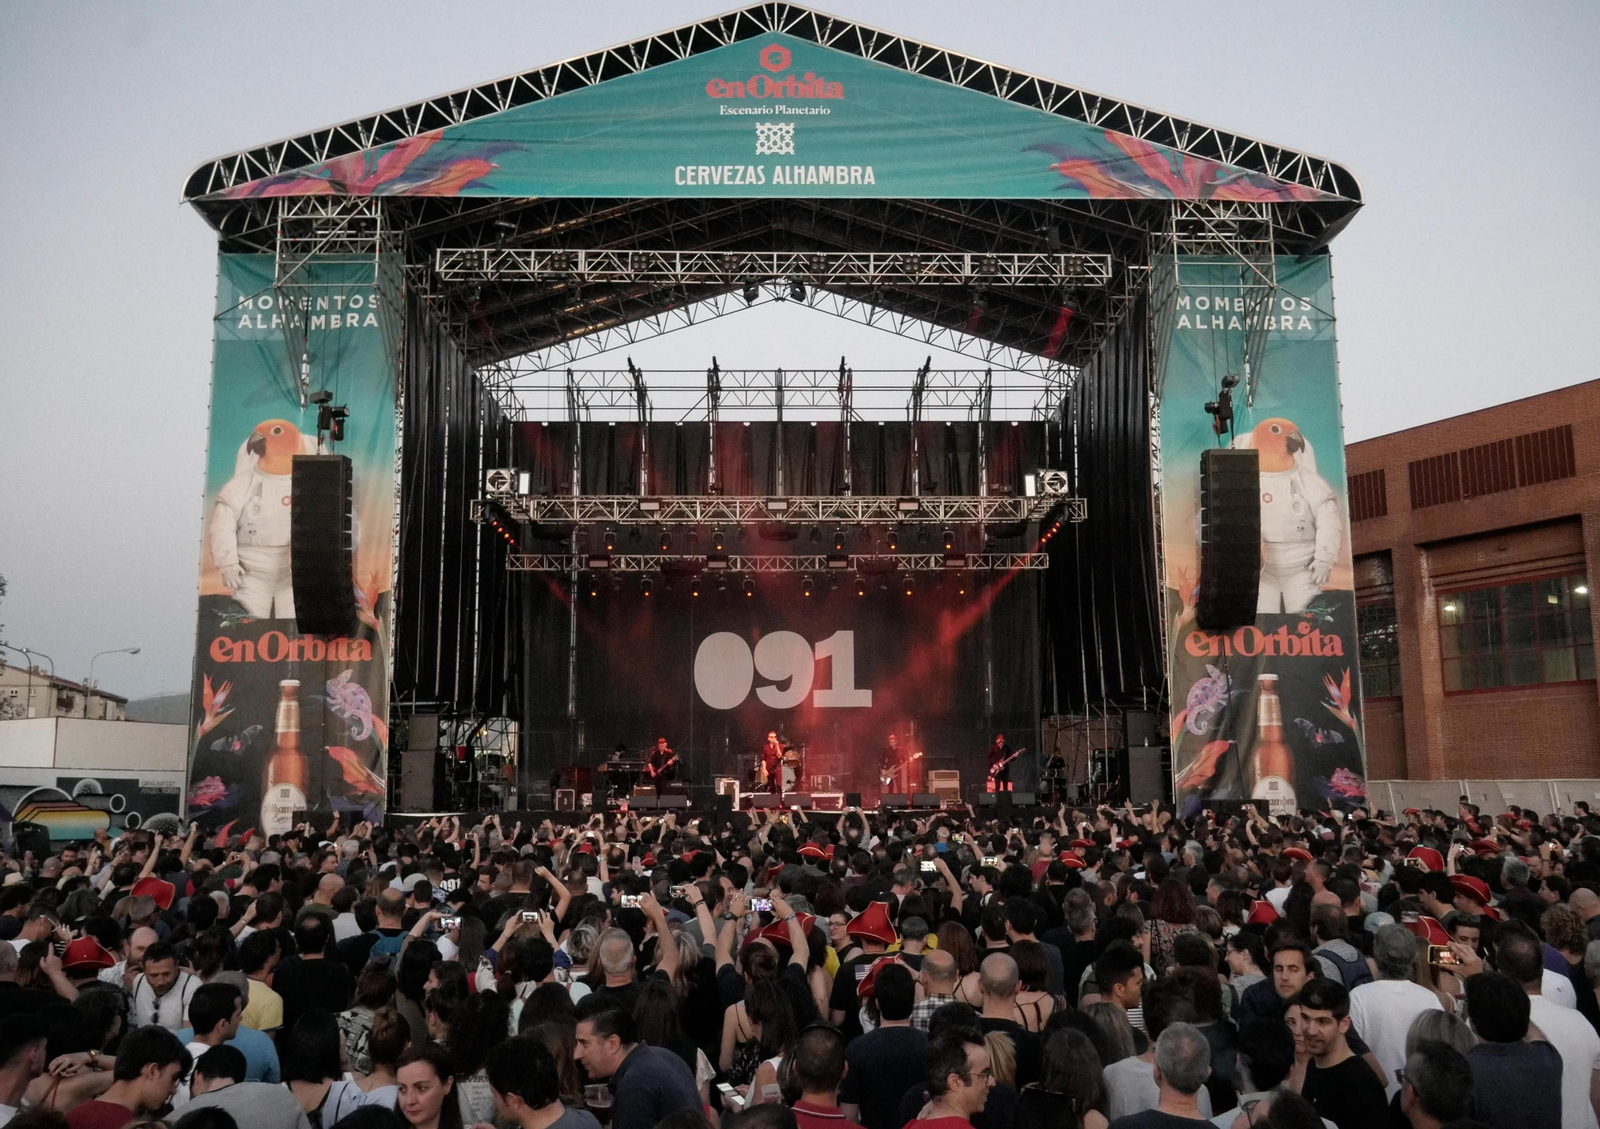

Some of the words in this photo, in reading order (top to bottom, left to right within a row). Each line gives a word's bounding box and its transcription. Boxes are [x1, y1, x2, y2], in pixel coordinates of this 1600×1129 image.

[719, 105, 774, 116] Escenario
[775, 104, 831, 116] Planetario
[674, 165, 766, 186] CERVEZAS
[772, 165, 876, 185] ALHAMBRA
[237, 312, 379, 331] ALHAMBRA
[1176, 314, 1313, 331] ALHAMBRA
[693, 630, 873, 710] 091
